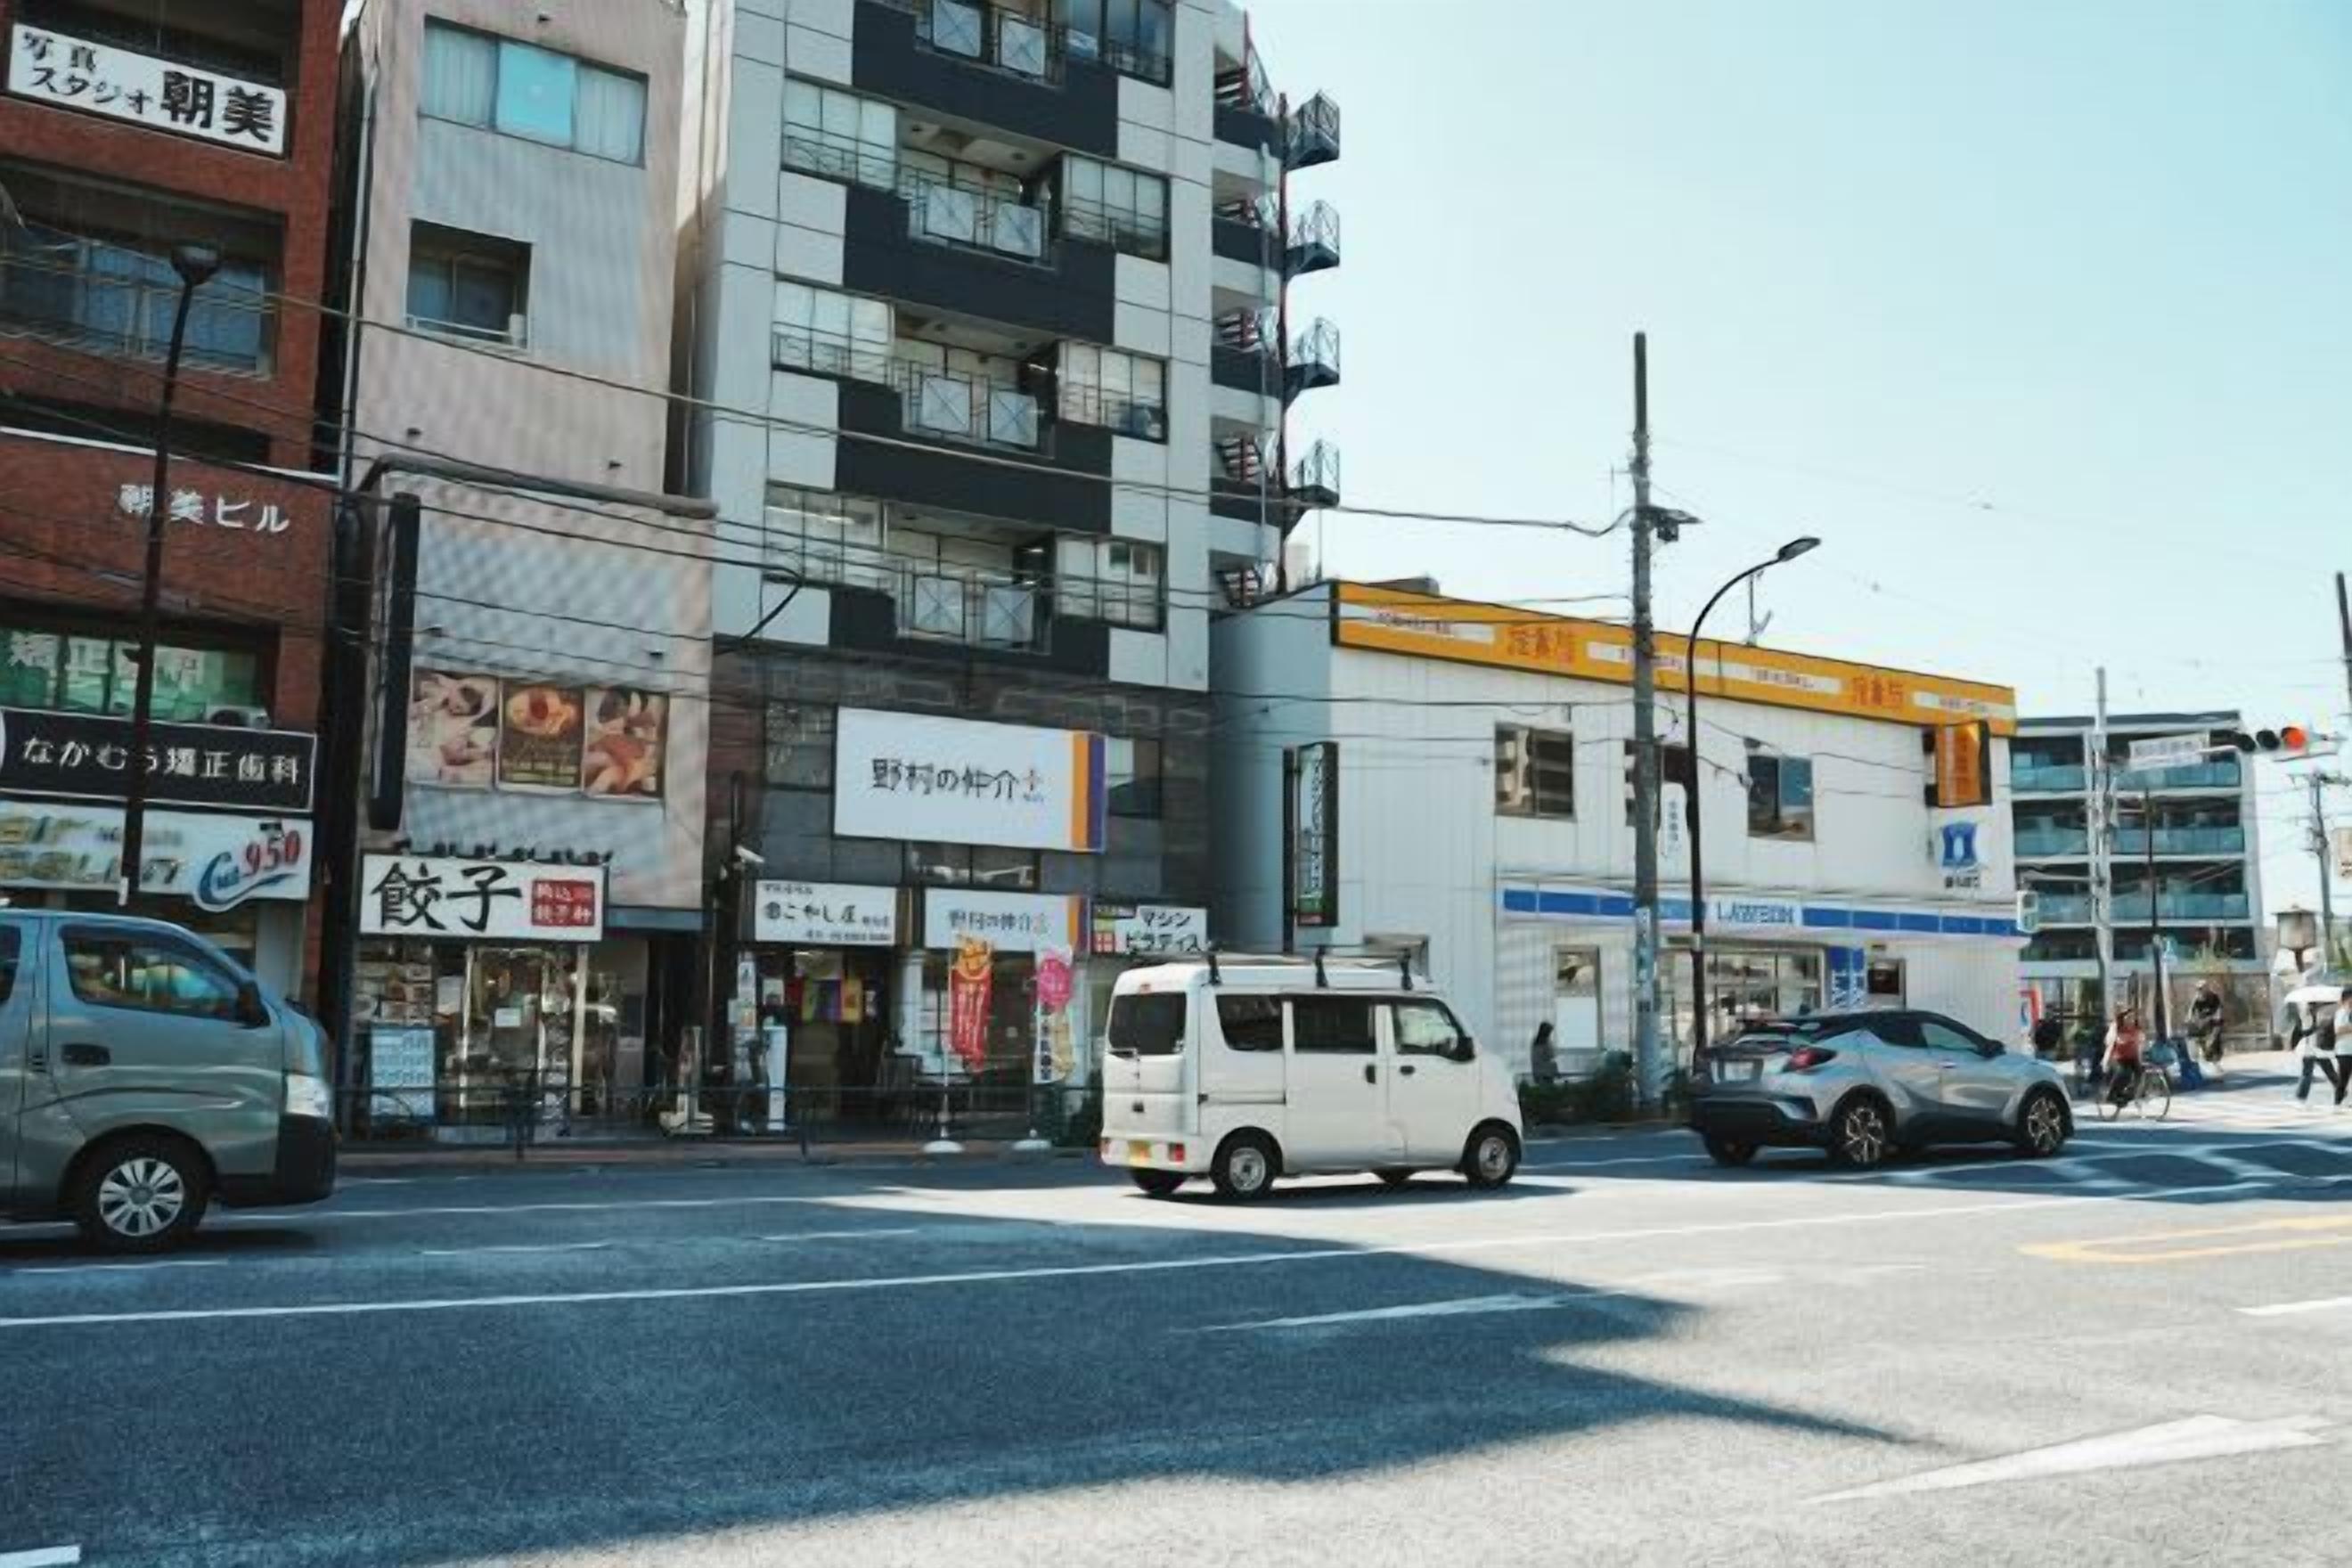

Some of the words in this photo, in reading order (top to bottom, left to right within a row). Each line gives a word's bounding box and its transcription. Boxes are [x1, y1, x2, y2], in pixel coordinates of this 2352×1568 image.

[32, 66, 153, 115] スタジオ
[160, 69, 275, 143] 朝美
[870, 758, 1020, 801] 野村の仲介
[372, 862, 522, 932] 餃子
